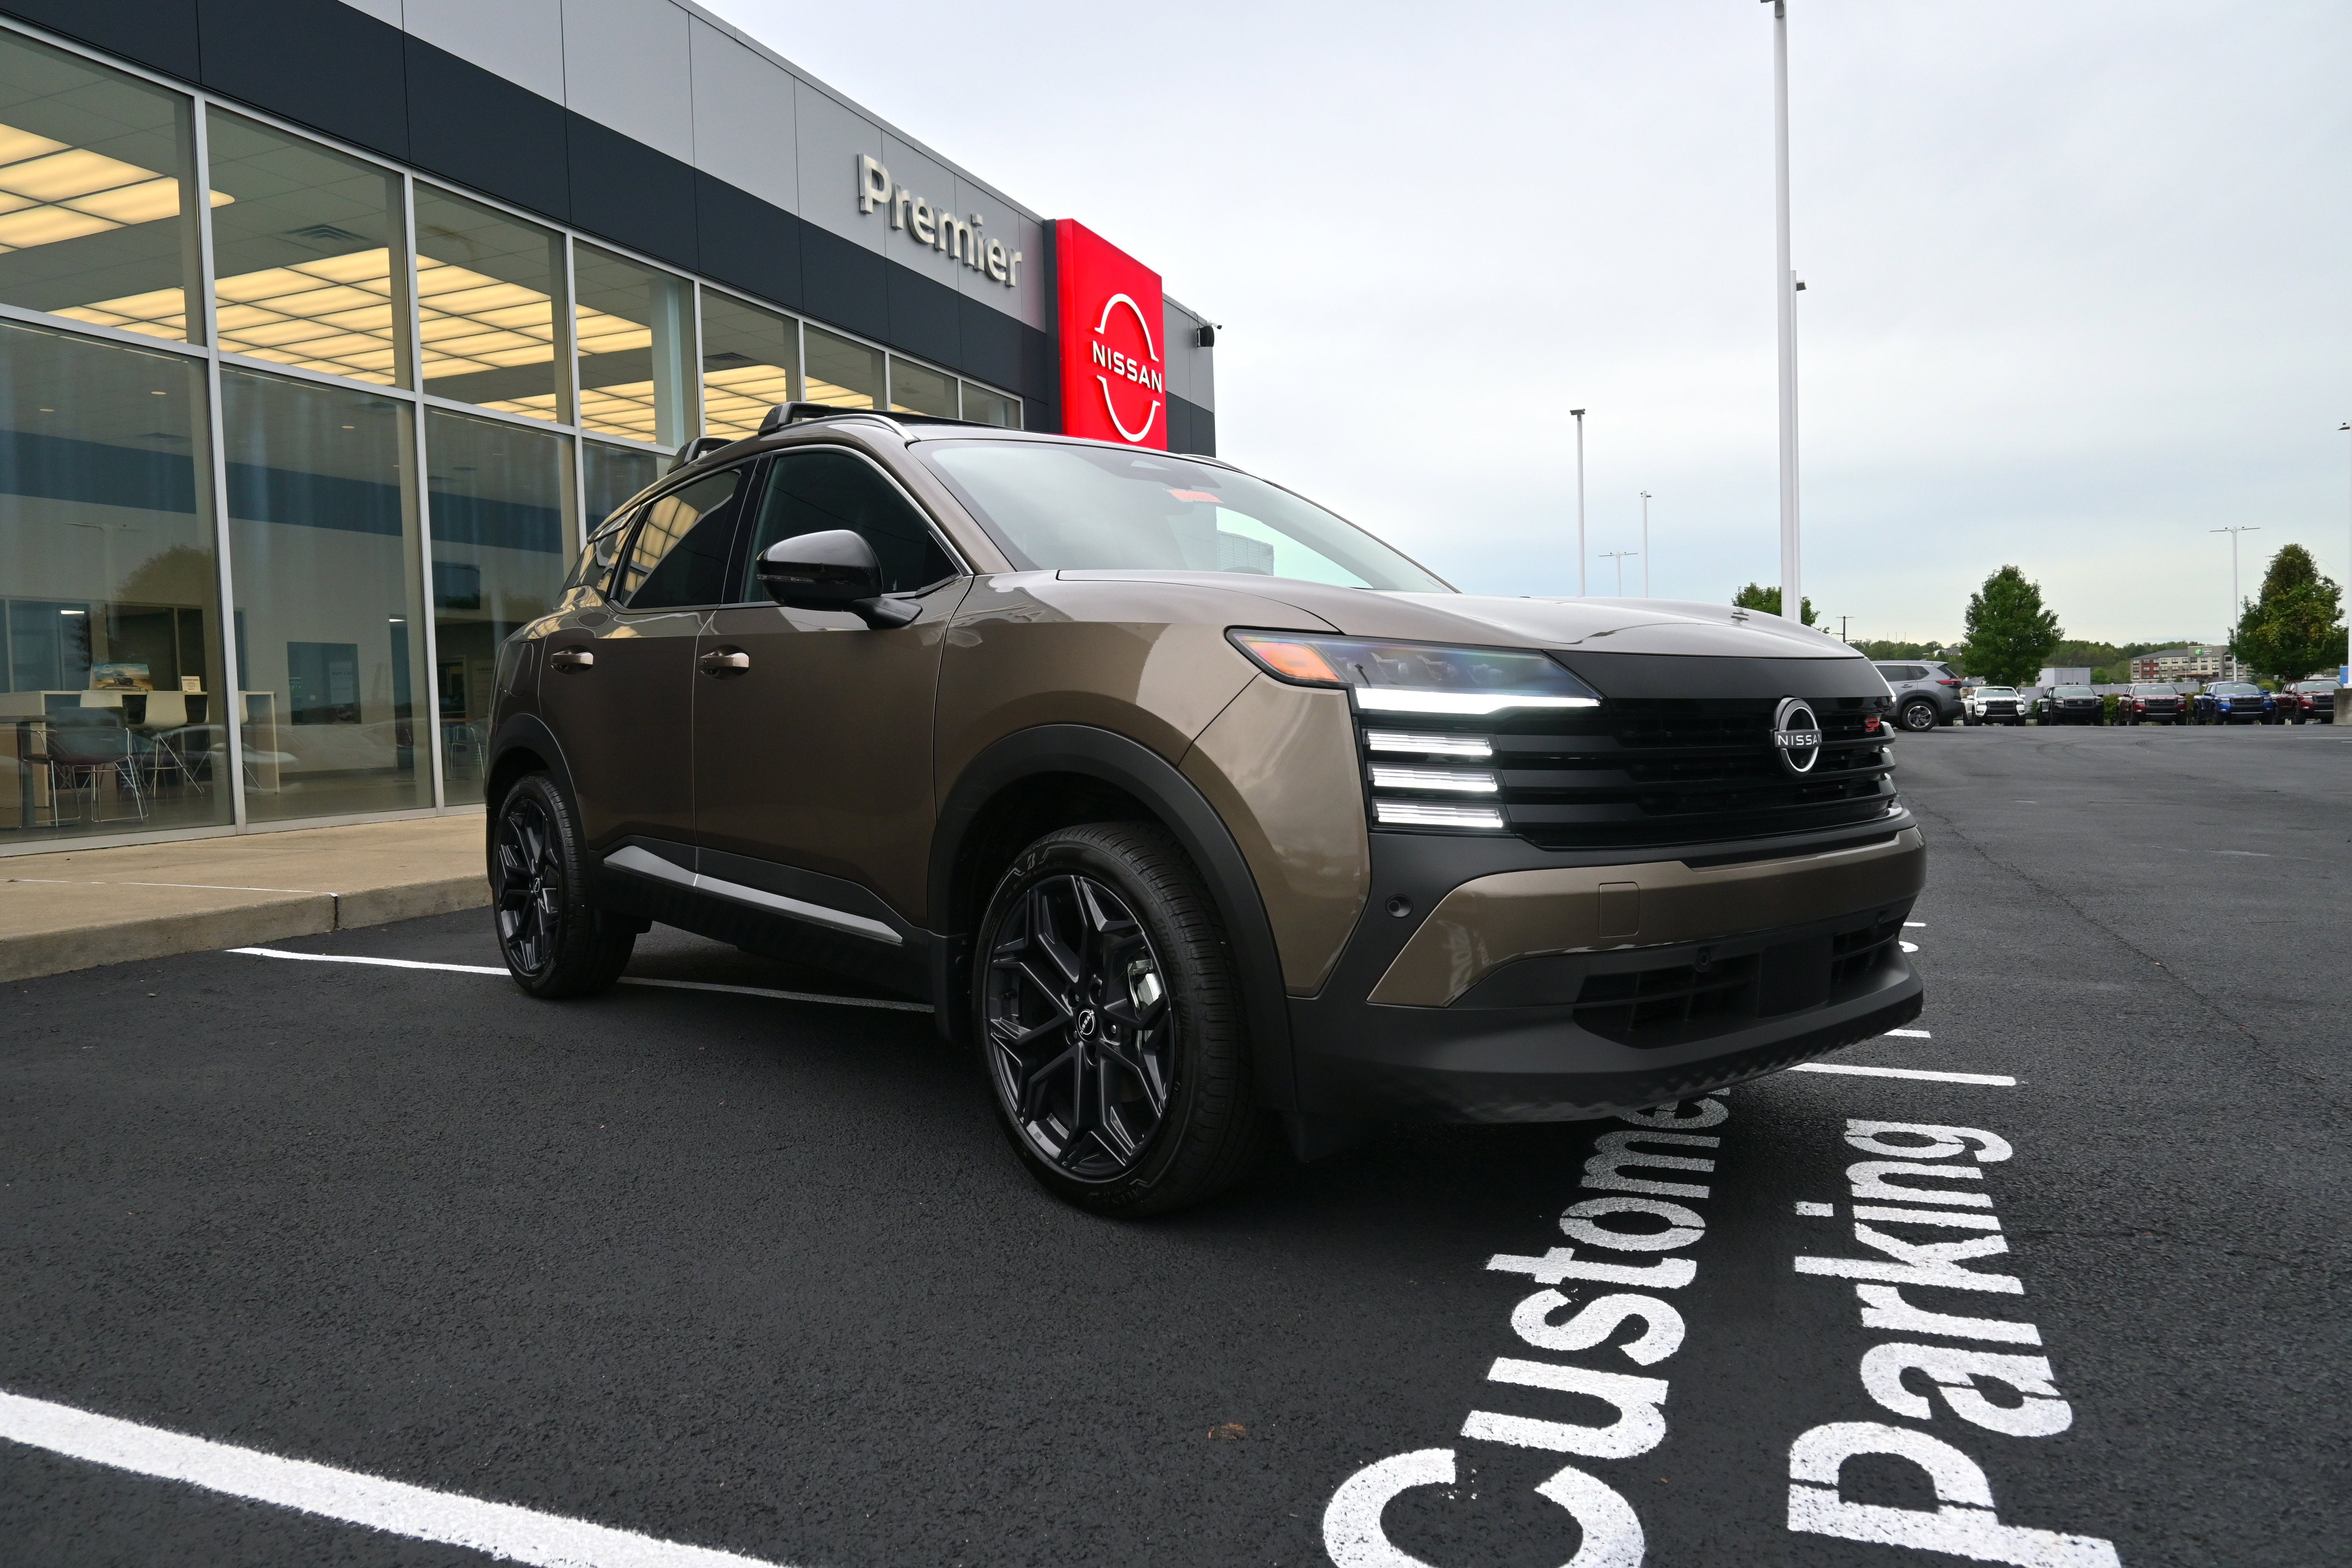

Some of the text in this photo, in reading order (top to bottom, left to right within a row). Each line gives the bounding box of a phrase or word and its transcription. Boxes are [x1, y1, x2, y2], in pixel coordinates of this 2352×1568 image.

[857, 153, 1022, 288] Premier
[1093, 340, 1162, 393] NISSAN
[1778, 733, 1822, 746] NISSAN
[1080, 1009, 1094, 1035] NISSAN
[1323, 1087, 1731, 1568] Custome
[1788, 1119, 2121, 1568] Parking
